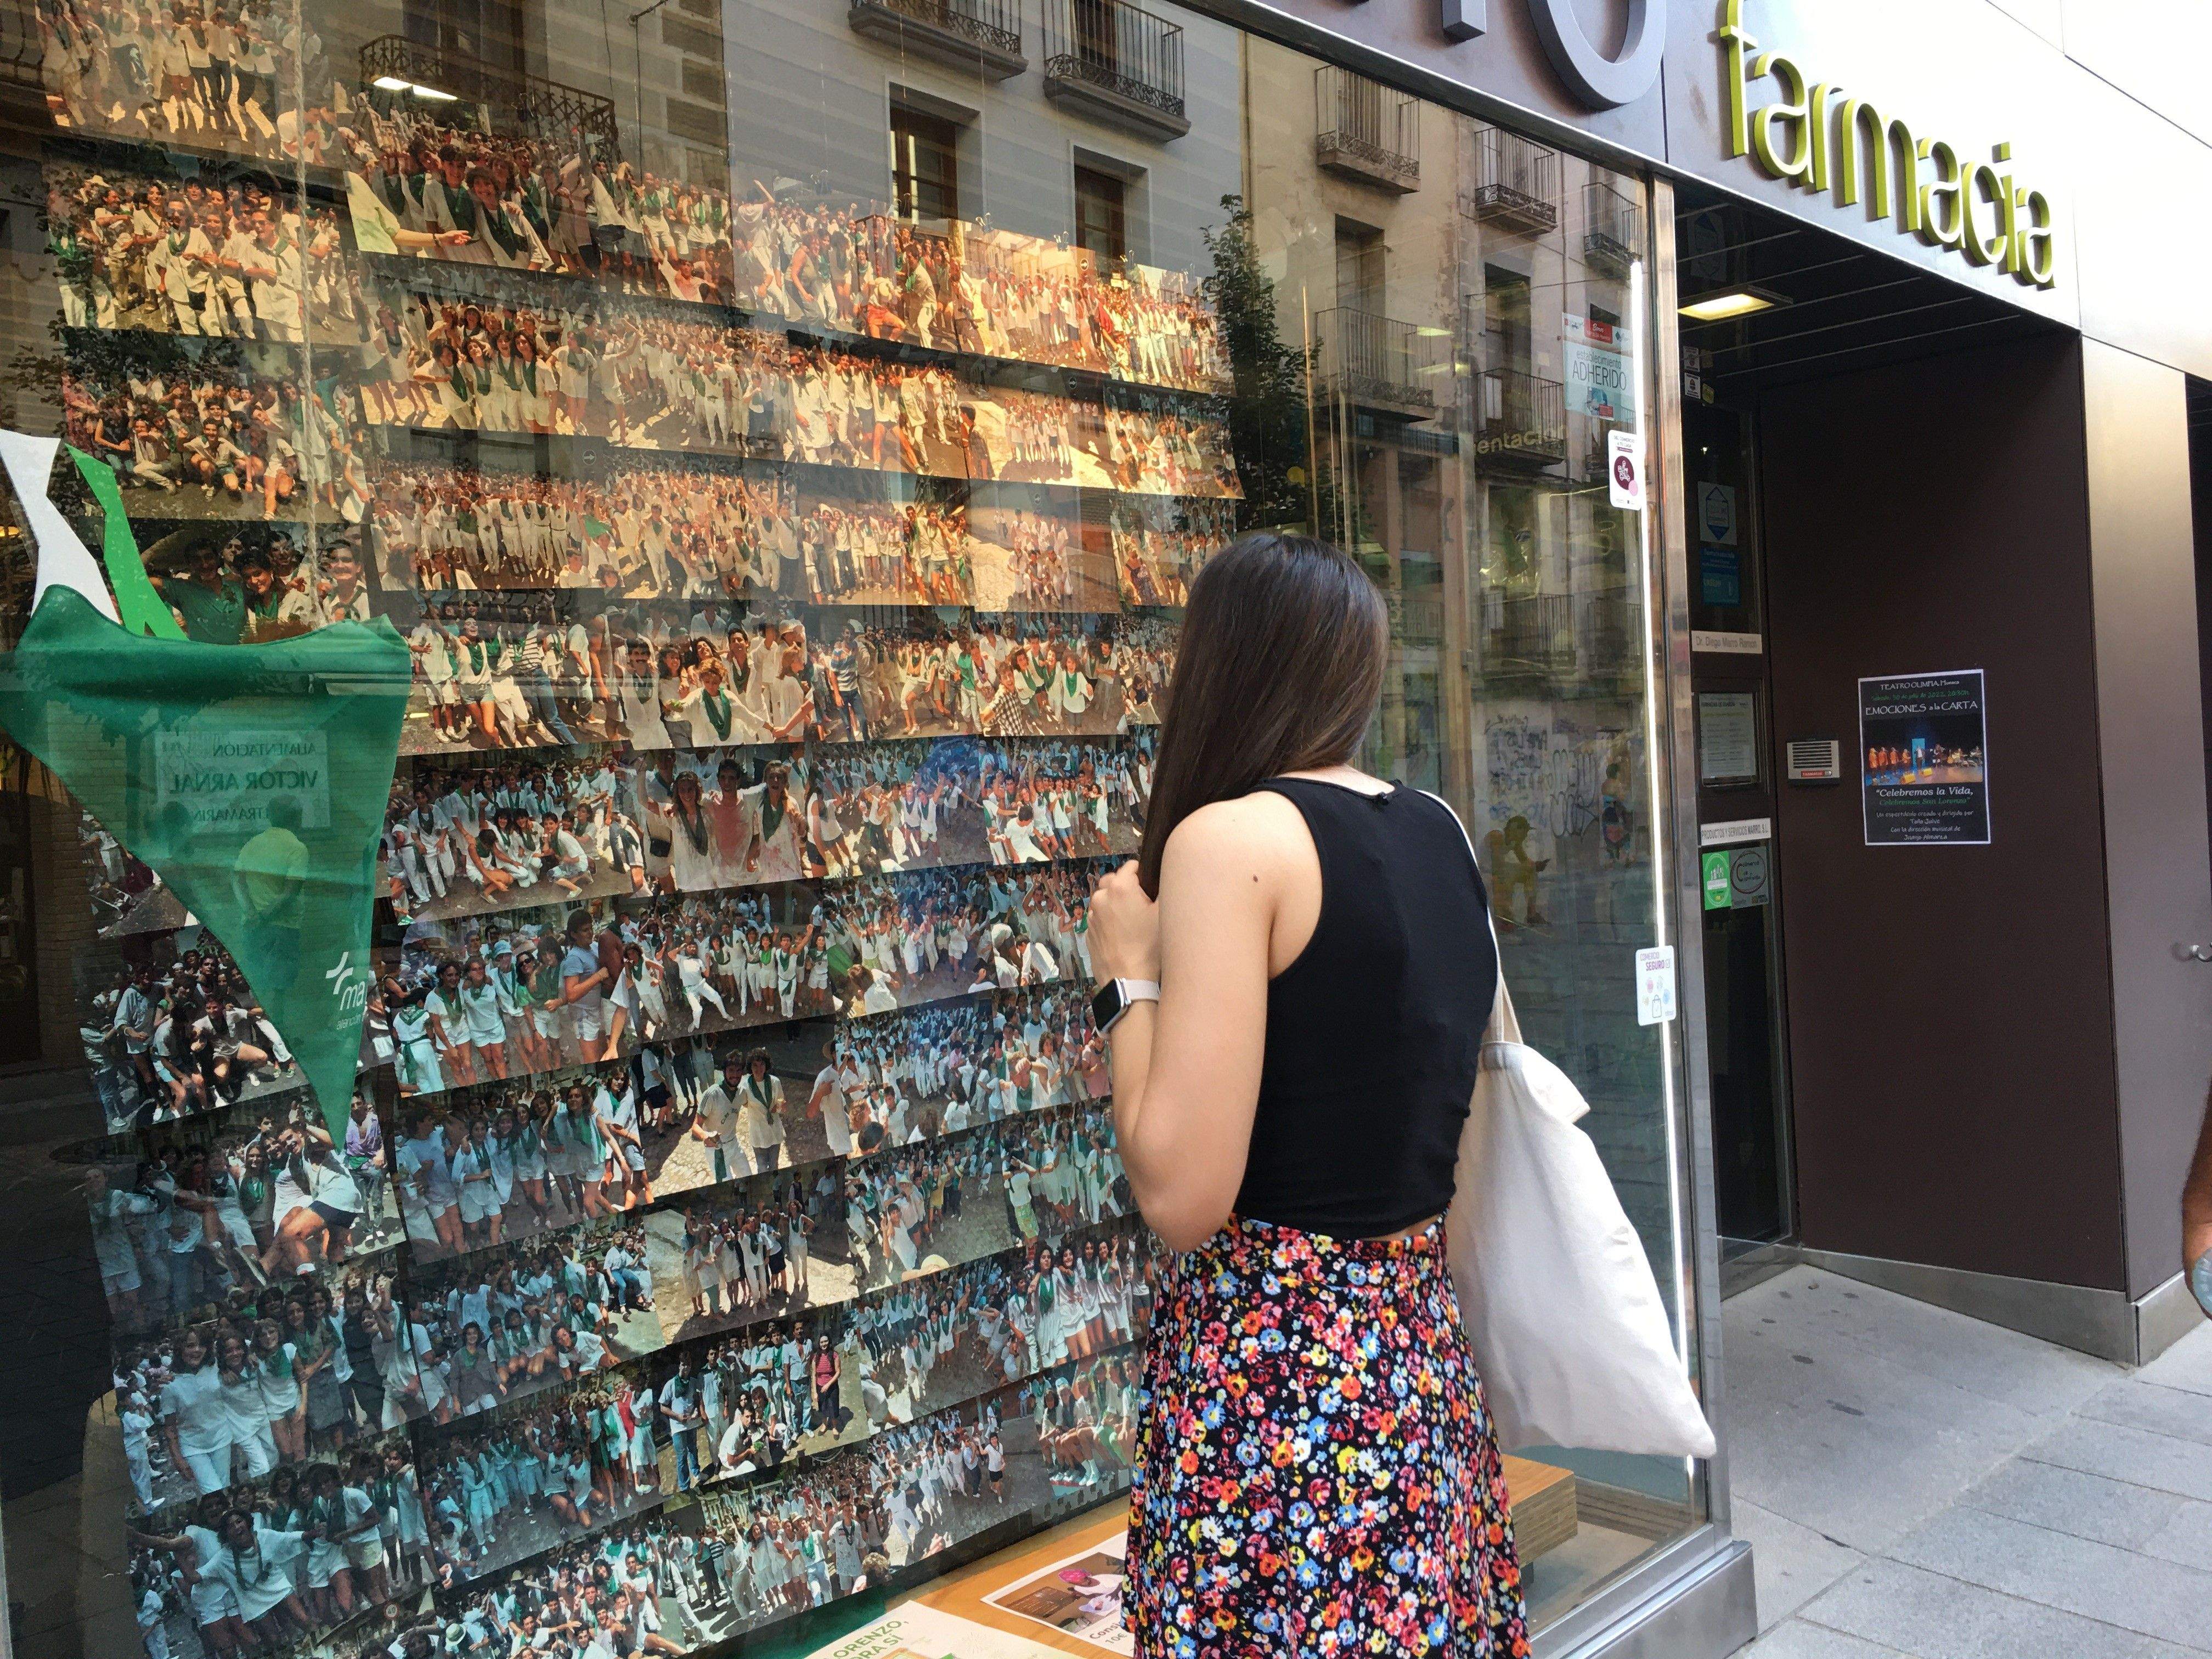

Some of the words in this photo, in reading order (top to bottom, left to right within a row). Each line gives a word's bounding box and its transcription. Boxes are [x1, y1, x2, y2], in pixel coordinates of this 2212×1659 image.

[1720, 0, 2056, 289] farmacia
[1572, 360, 1627, 391] ADHERIDO
[1880, 682, 1910, 691] TEATRO
[1865, 703, 1927, 715] EMOCIONES
[1941, 701, 1978, 710] CARTA
[1936, 787, 1946, 795] la
[1949, 786, 1973, 796] Vida,
[1640, 951, 1660, 961] COMERCIO
[1645, 960, 1665, 971] SEGURO
[1105, 1633, 1127, 1644] 10€
